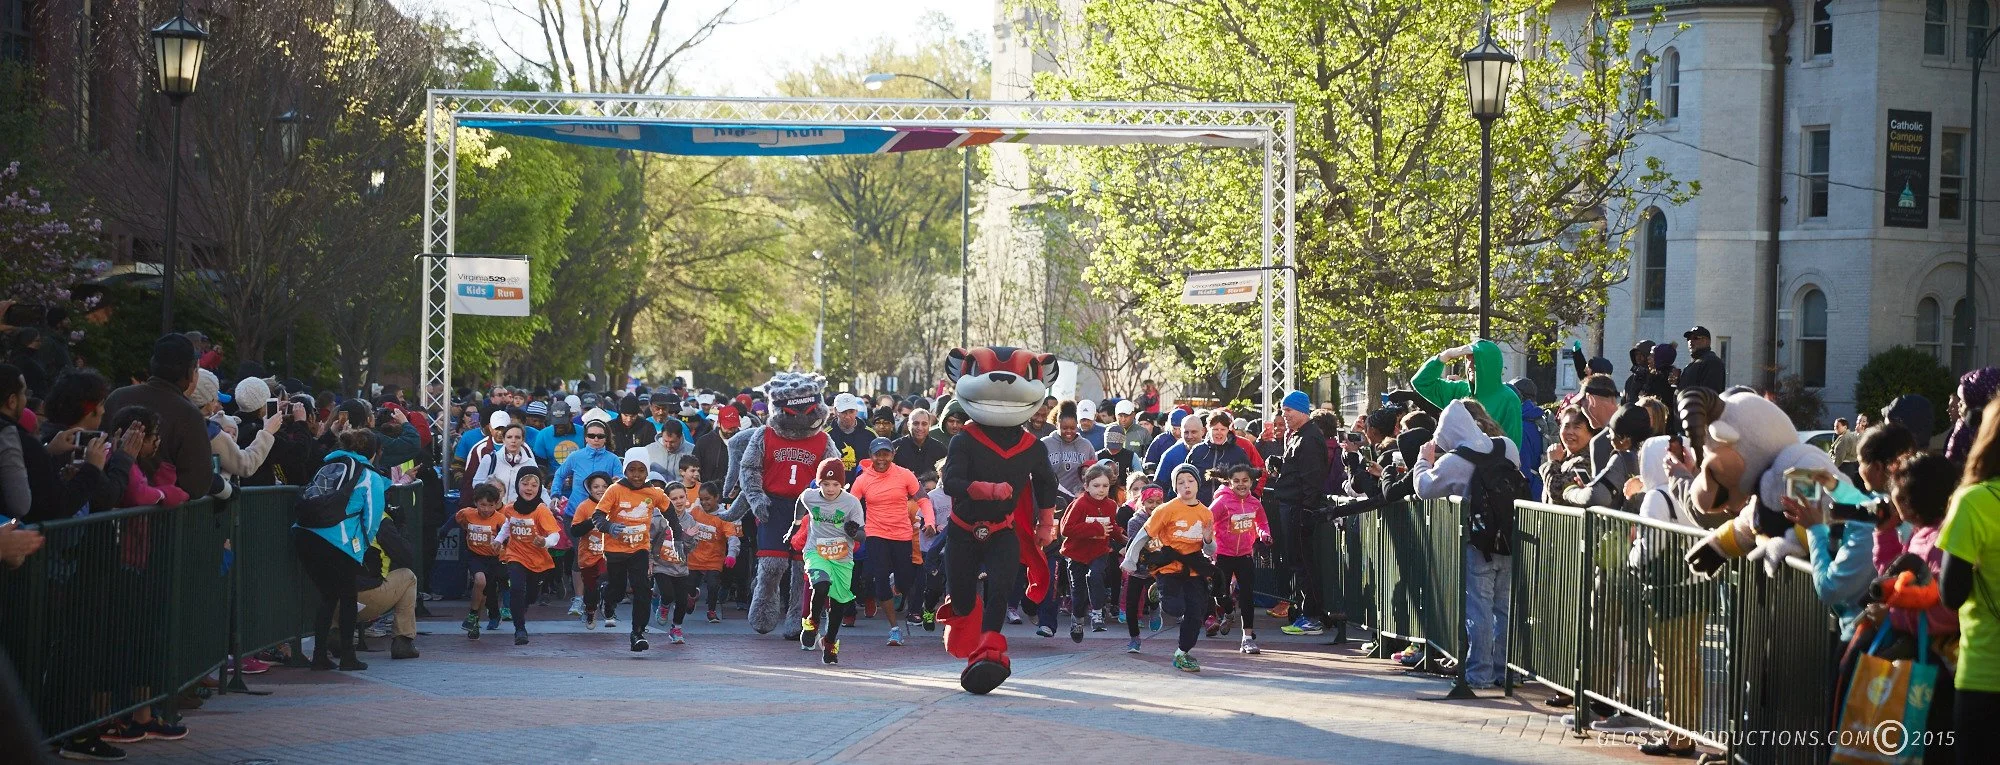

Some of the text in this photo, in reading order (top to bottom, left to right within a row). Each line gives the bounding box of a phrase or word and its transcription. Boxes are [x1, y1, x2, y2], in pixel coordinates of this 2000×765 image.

[1890, 119, 1924, 131] Catholic
[1890, 130, 1923, 143] Campus
[1890, 142, 1922, 155] Ministry
[466, 285, 515, 298] Kids Run
[786, 396, 816, 406] RICHMOND
[773, 447, 817, 466] SPIDERS
[788, 464, 798, 485] 1
[468, 531, 489, 542] 2058
[510, 525, 533, 536] 2002
[820, 544, 844, 555] 2407
